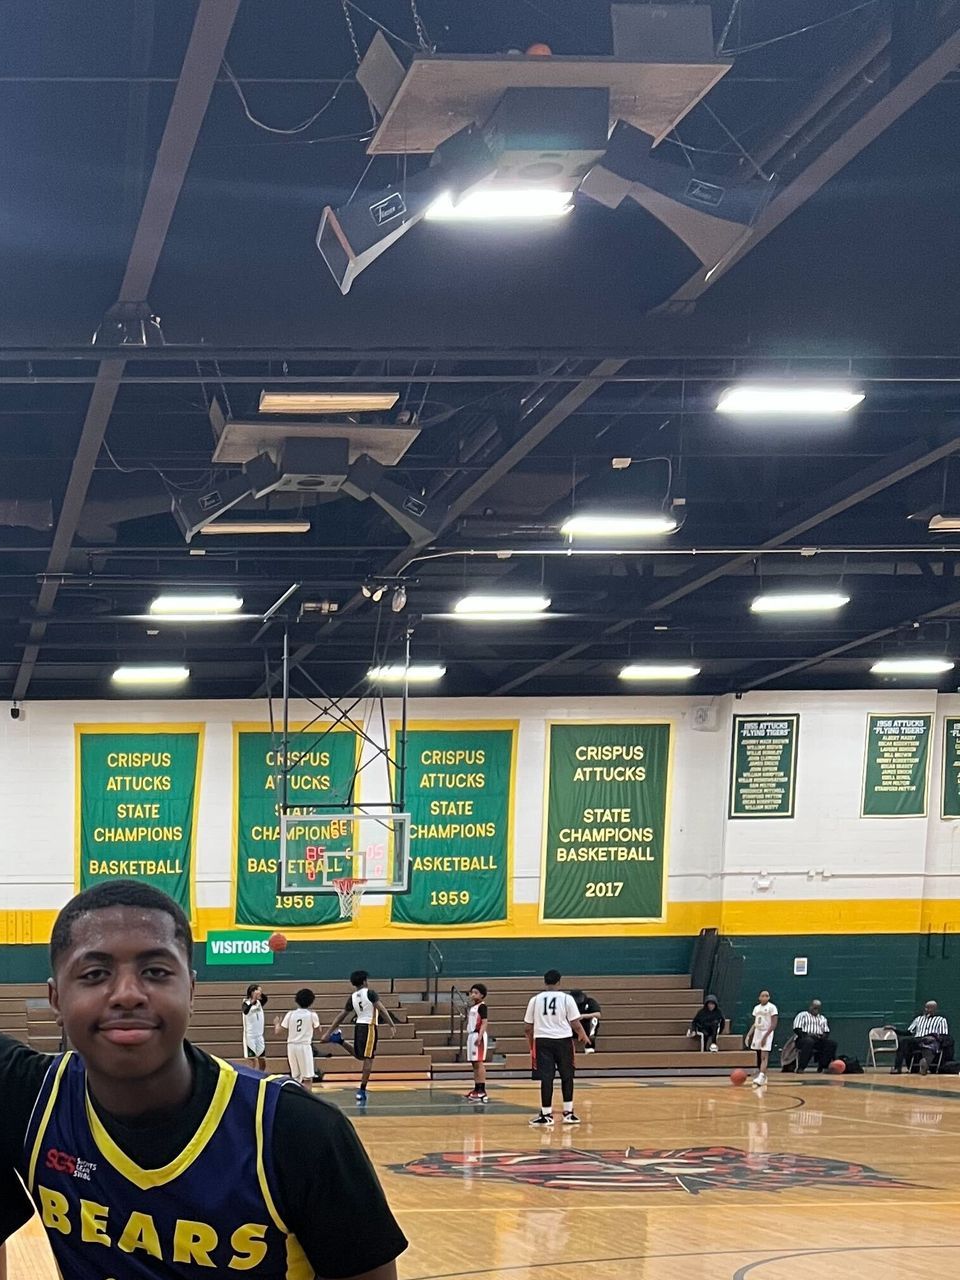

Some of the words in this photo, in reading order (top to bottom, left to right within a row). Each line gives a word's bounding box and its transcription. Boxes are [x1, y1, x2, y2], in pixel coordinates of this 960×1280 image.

[759, 722, 788, 730] ATTUCKS
[107, 752, 171, 768] CRISPUS
[421, 750, 485, 765] CRISPUS
[575, 746, 644, 760] CRISPUS
[420, 774, 485, 788] ATTUCKS
[574, 766, 646, 782] ATTUCKS
[106, 775, 171, 791] ATTUCKS
[265, 775, 330, 790] AUCKS
[116, 804, 160, 819] STATE
[430, 802, 474, 816] STATE
[583, 808, 631, 822] STATE
[93, 826, 183, 842] CHAMPIONS
[409, 822, 496, 838] CHAMPIONS
[559, 827, 654, 842] CHAMPIONS
[556, 846, 655, 862] BASKETBALL
[89, 859, 184, 875] BASKETBALL
[247, 858, 342, 874] BASETBALL
[412, 856, 498, 871] ASKETBALL
[585, 882, 624, 898] 2017
[275, 895, 314, 909] 1956
[430, 890, 470, 906] 1959
[211, 940, 270, 954] VISITORS
[542, 997, 557, 1016] 14
[296, 1018, 303, 1032] 2
[38, 1184, 269, 1270] BEARS
